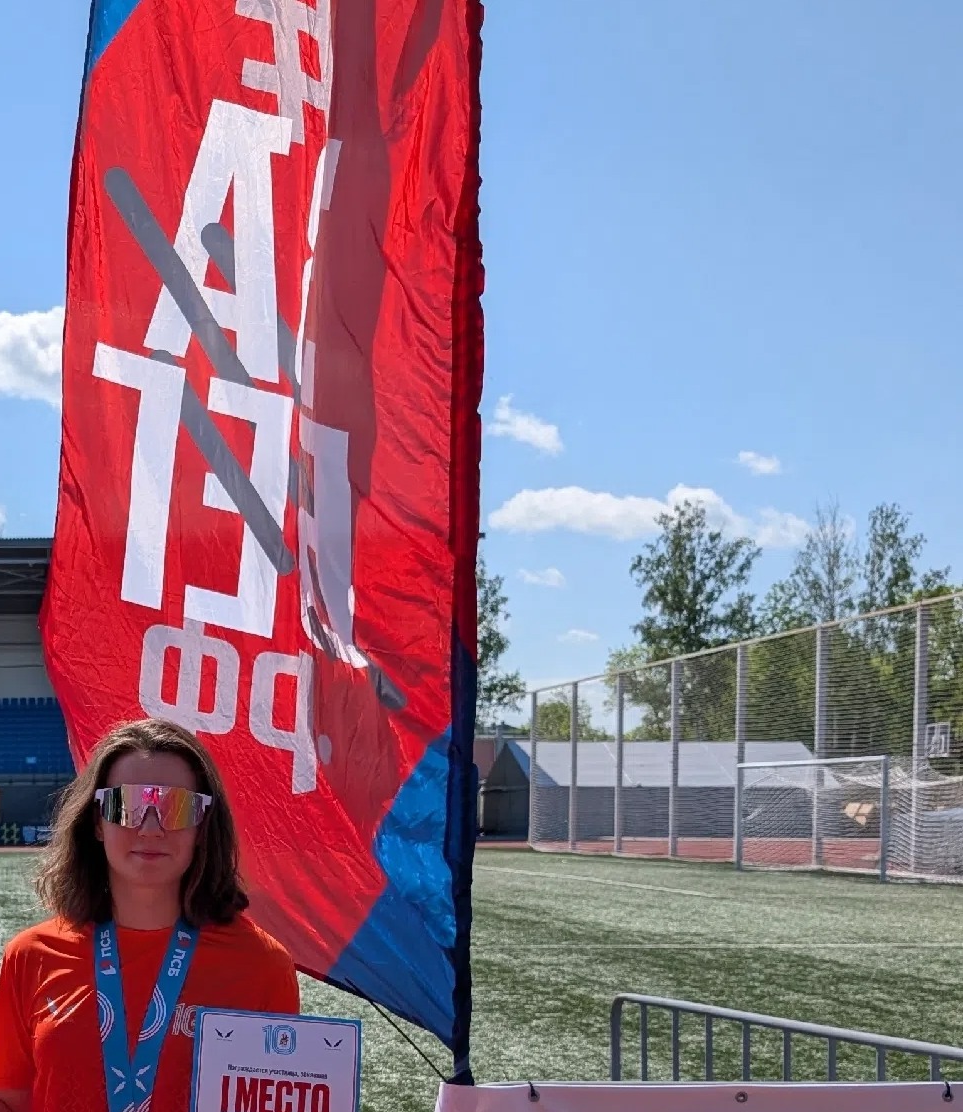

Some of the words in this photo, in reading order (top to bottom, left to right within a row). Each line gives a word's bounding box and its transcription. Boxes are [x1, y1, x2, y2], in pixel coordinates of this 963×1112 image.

[100, 929, 112, 958] ПСБ
[167, 948, 187, 977] ПСБ
[261, 1024, 297, 1055] 10
